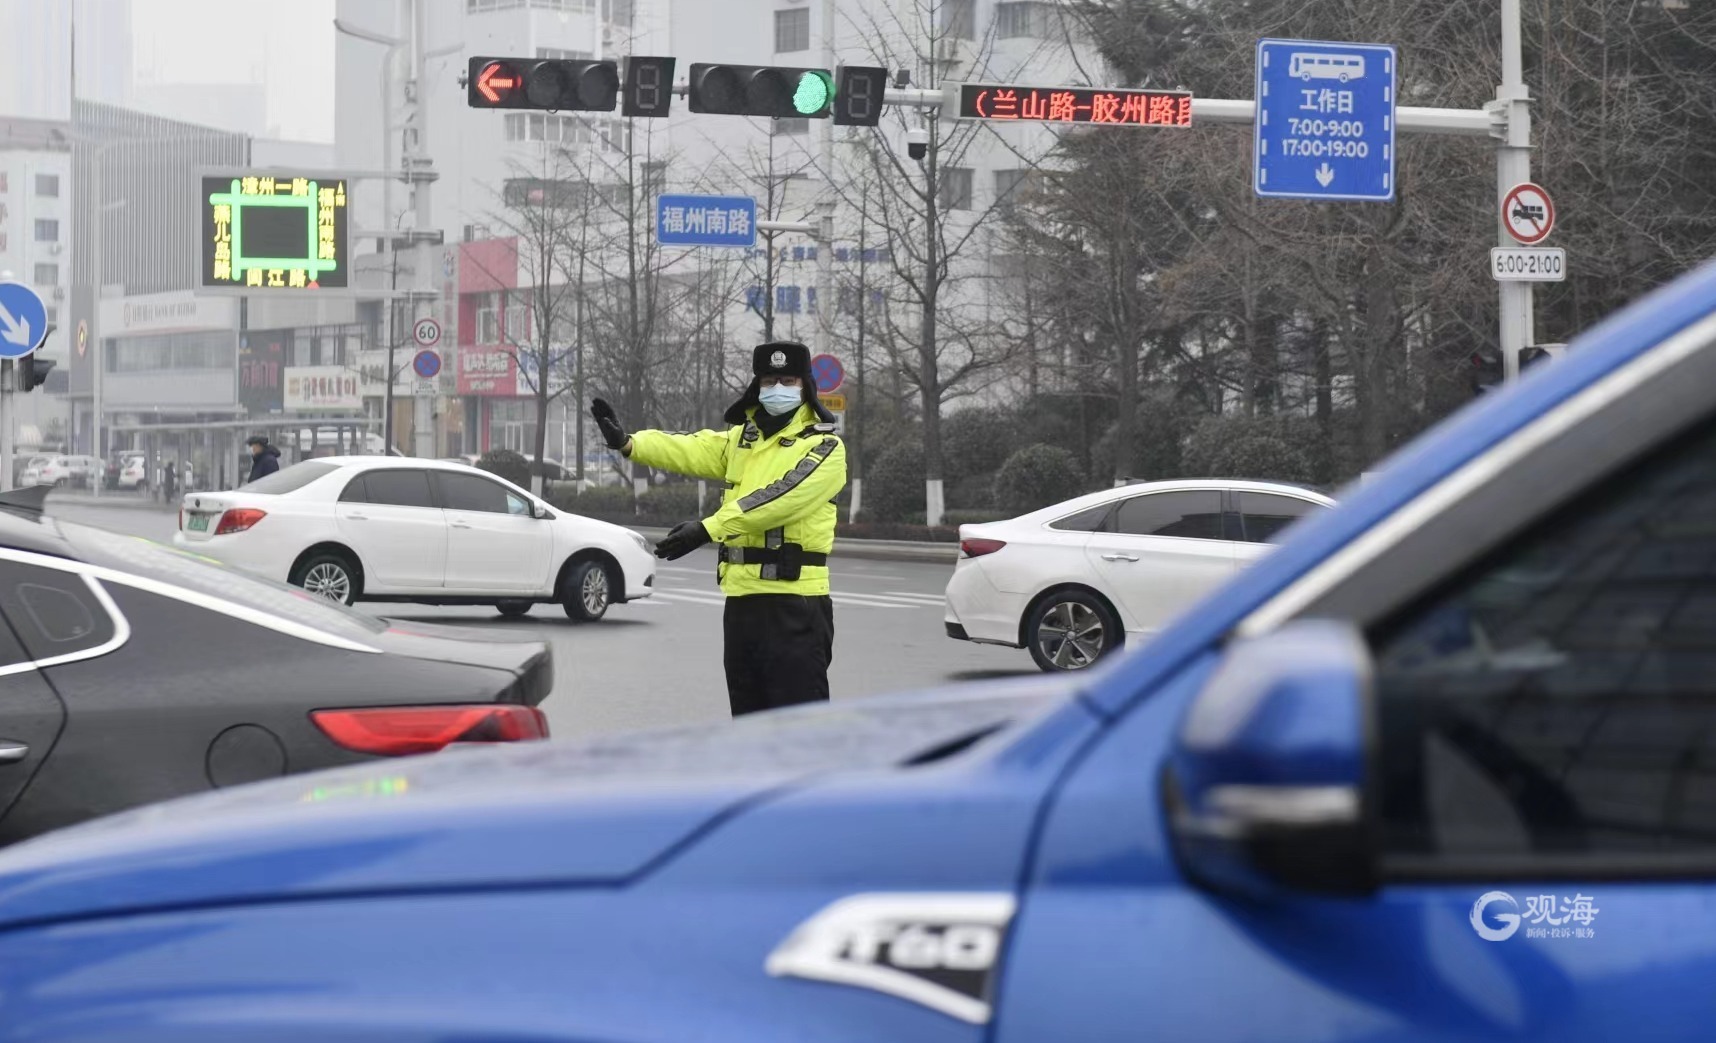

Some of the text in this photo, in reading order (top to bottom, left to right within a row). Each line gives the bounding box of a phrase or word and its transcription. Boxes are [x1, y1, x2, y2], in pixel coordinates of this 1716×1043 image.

[1299, 88, 1354, 114] 工作日
[1288, 118, 1364, 138] 7:00-9:00
[1282, 139, 1369, 159] 17:00-19:00
[241, 177, 308, 196] 漳州一路
[662, 206, 751, 236] 福州南路
[1496, 255, 1561, 274] 6:00-21:00
[419, 326, 435, 339] 60
